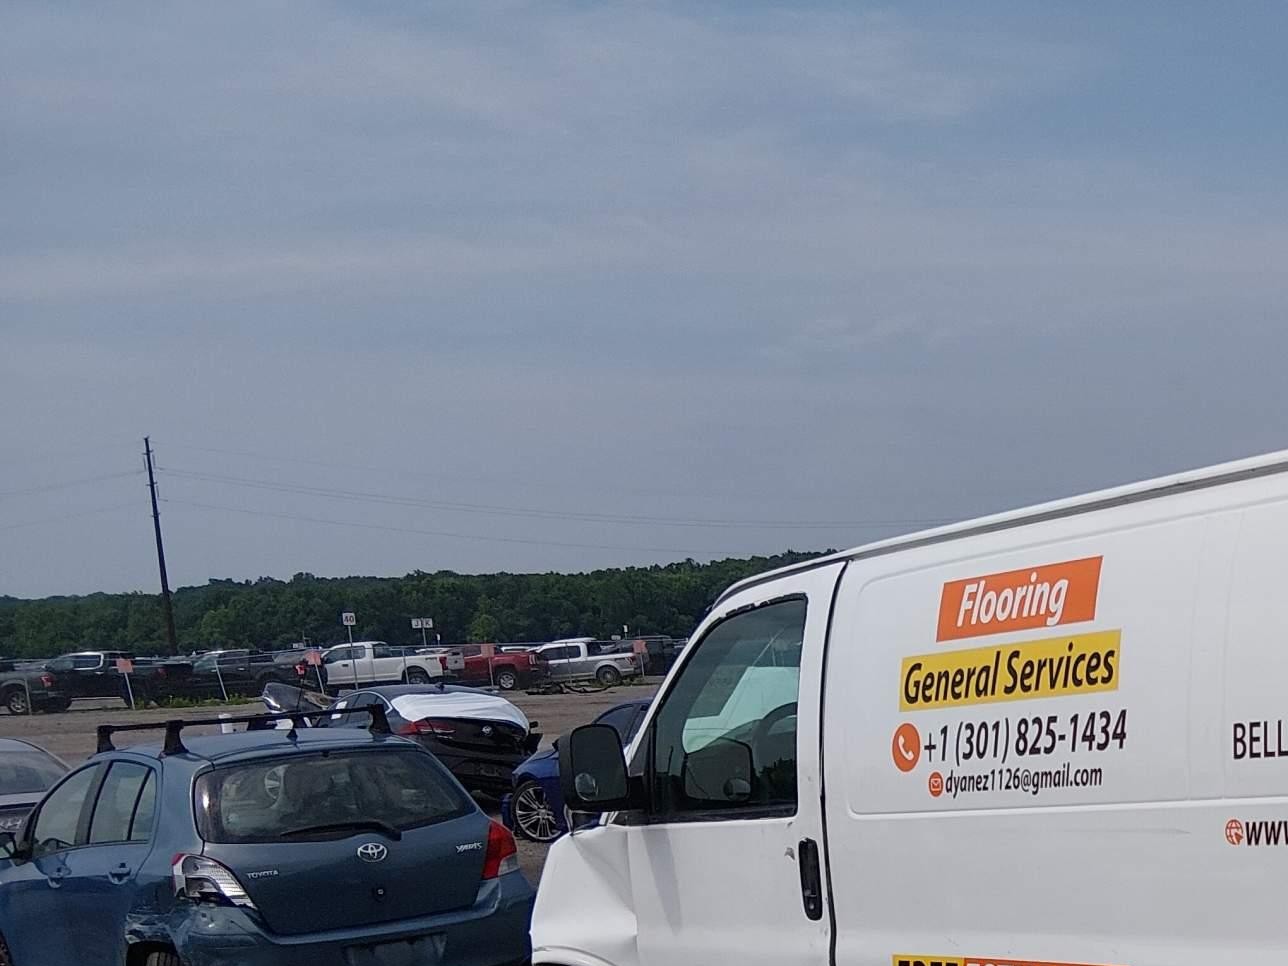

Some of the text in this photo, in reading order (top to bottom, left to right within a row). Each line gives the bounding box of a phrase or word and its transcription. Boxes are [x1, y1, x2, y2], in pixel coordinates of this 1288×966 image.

[344, 615, 355, 624] 40
[956, 571, 1069, 627] Flooring
[904, 642, 1116, 705] General Services
[923, 709, 1128, 766] +1 (301) 825-1434
[945, 763, 1103, 798] dyanez1126@gmail.com
[246, 870, 279, 879] TOYOTA
